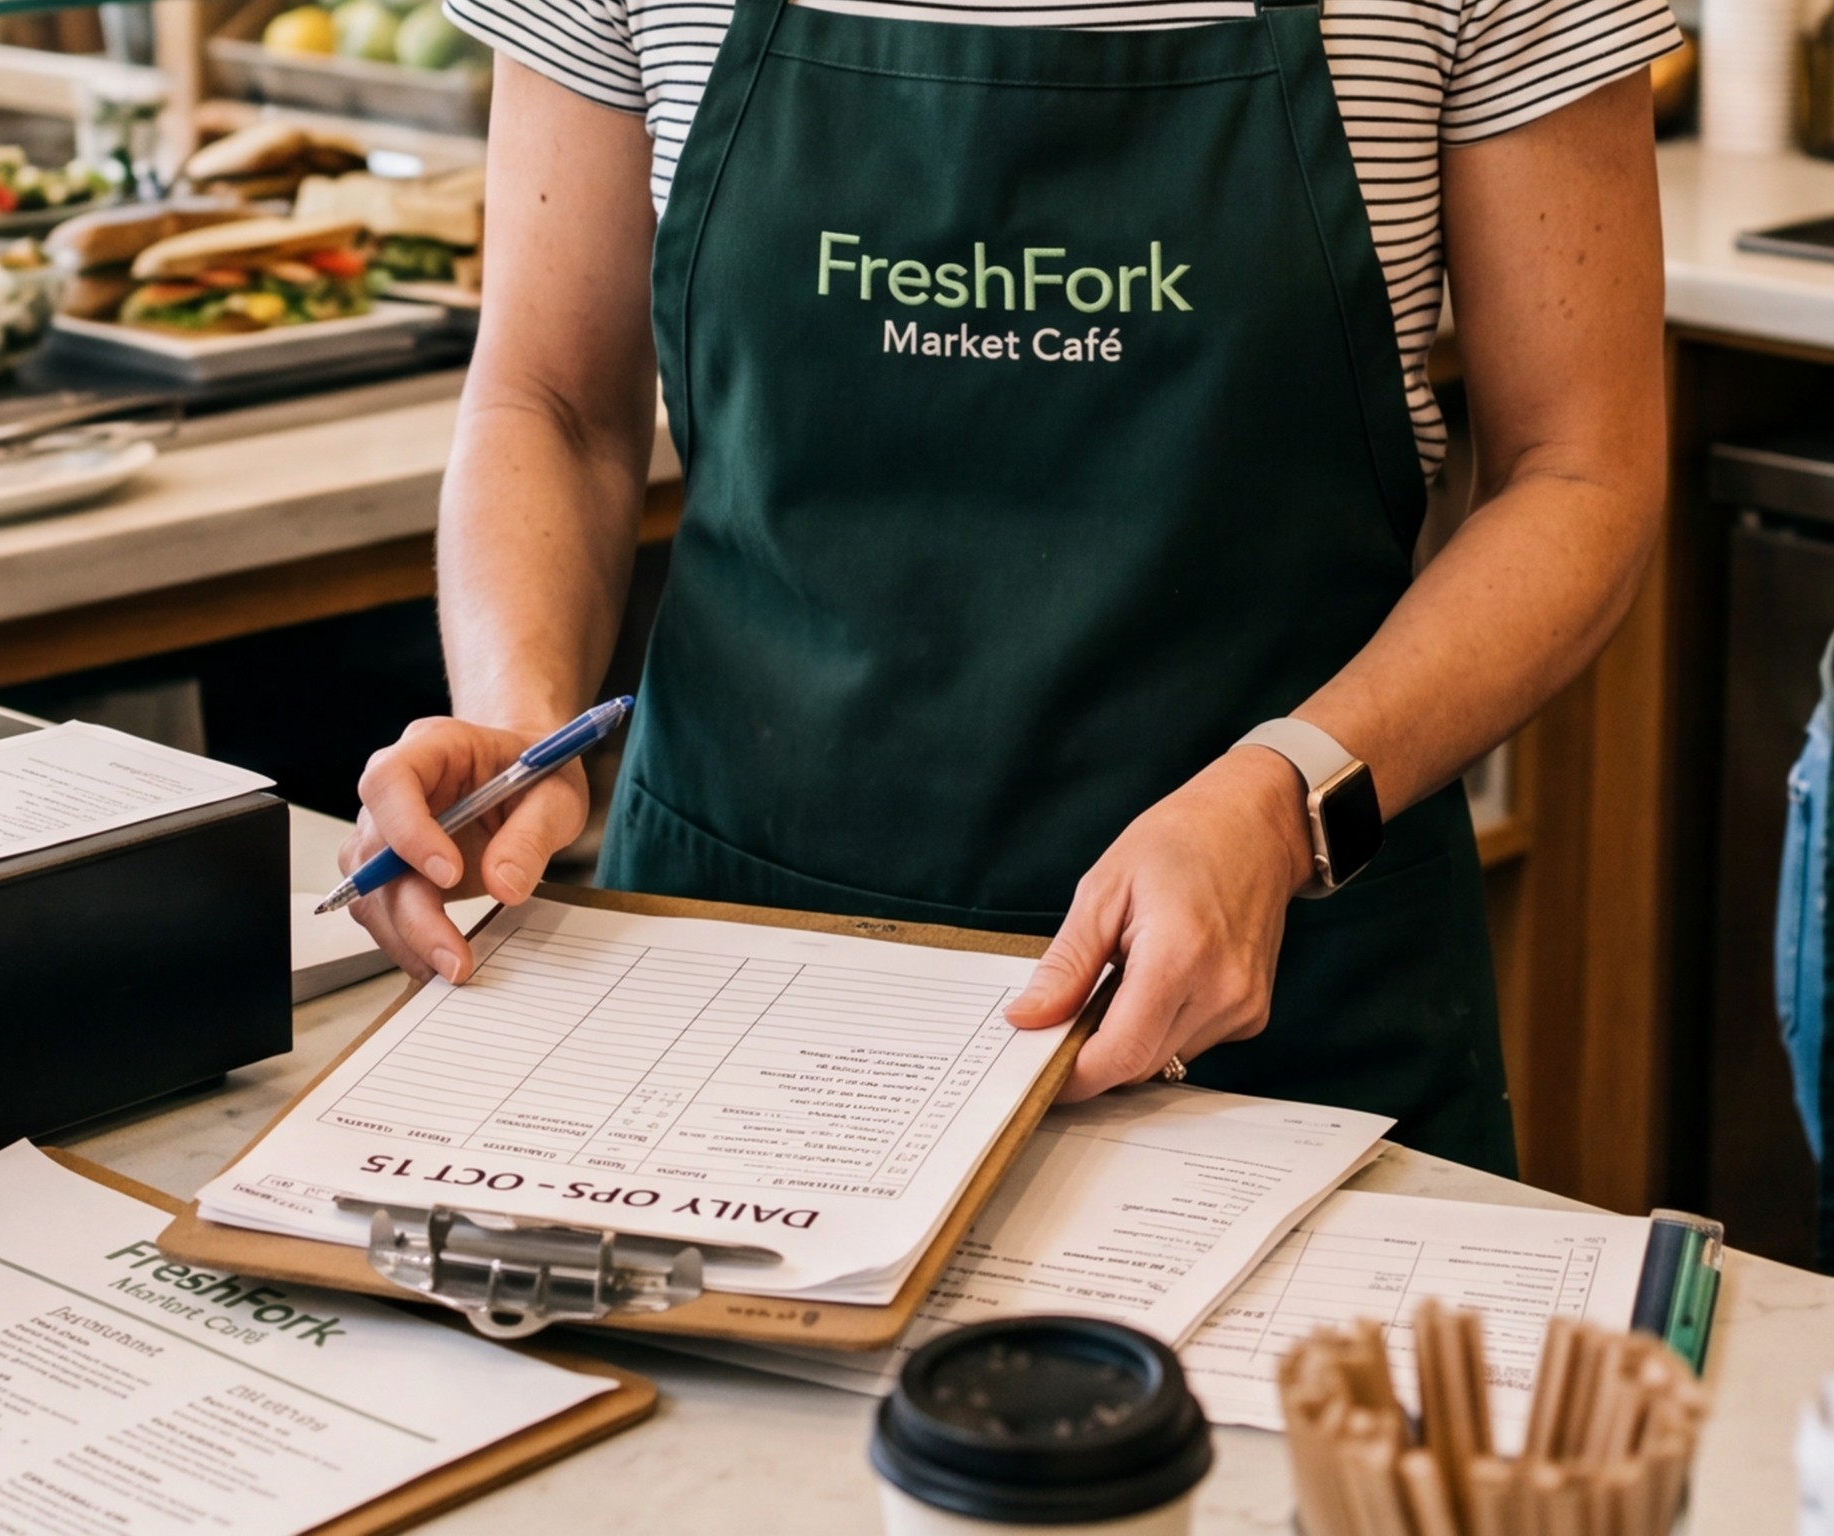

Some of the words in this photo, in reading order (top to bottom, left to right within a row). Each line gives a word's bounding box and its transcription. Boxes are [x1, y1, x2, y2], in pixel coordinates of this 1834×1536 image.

[818, 230, 1194, 313] FreshFork
[882, 319, 1020, 361] Market
[1032, 327, 1122, 363] Café
[360, 1154, 415, 1177] 15
[423, 1164, 525, 1191] OCT
[562, 1181, 661, 1207] OPS
[672, 1196, 820, 1229] DAILY
[104, 1240, 347, 1347] FreshFork
